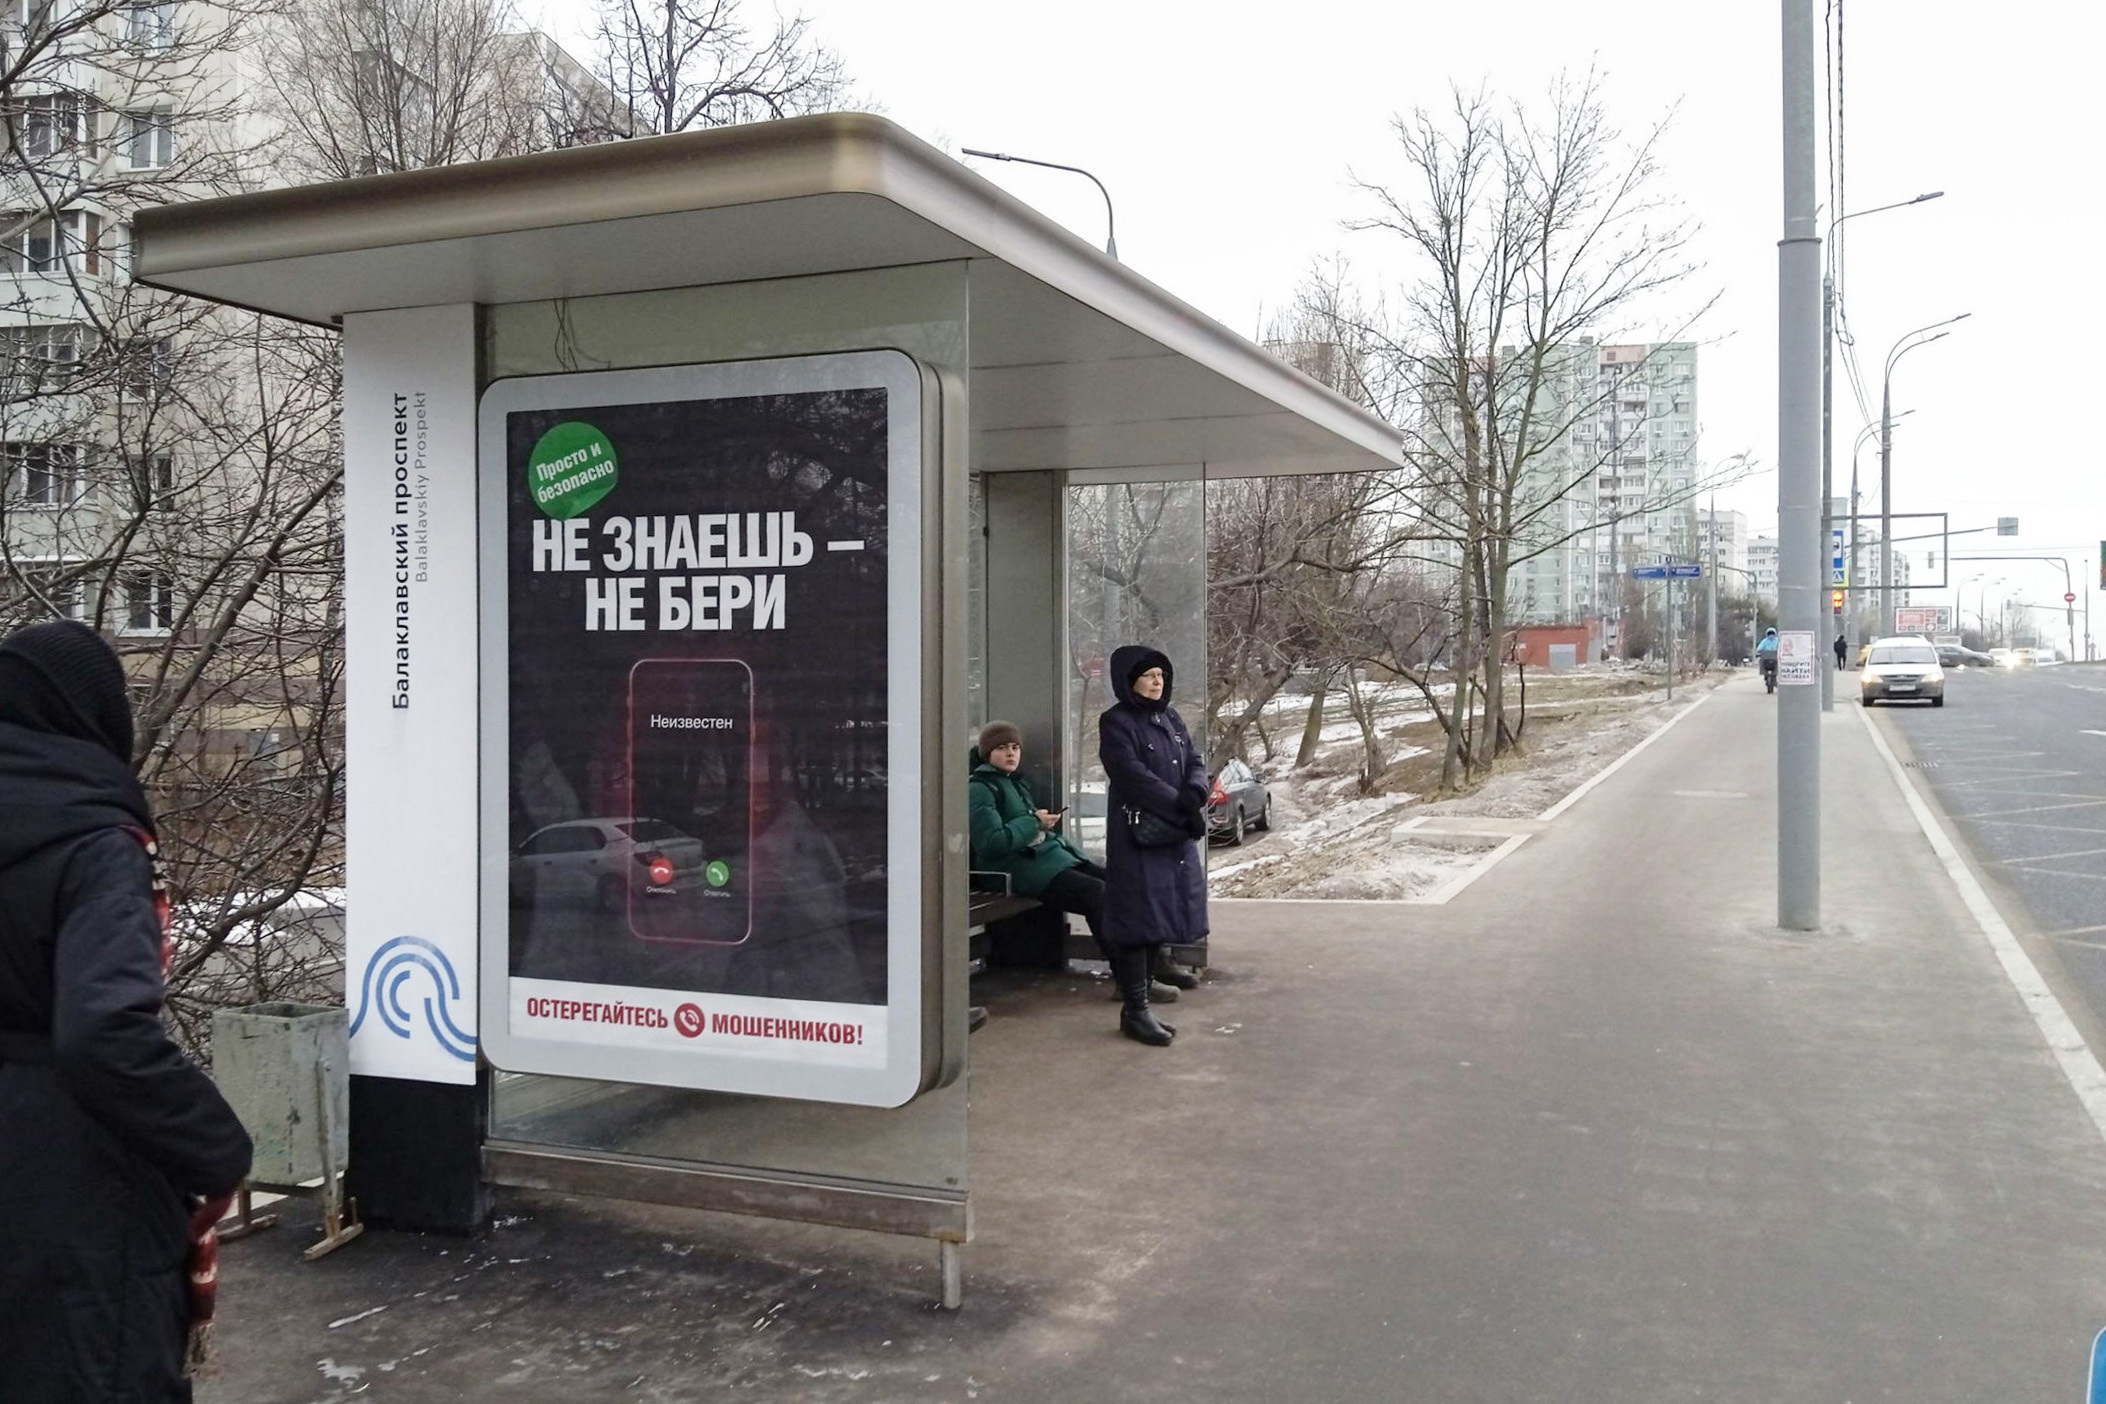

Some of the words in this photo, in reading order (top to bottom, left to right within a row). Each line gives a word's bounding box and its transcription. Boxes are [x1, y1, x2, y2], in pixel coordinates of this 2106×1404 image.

[395, 393, 412, 514] проспект
[413, 391, 429, 469] Prospekt
[536, 449, 588, 481] Просто
[590, 442, 602, 458] и
[537, 460, 614, 503] безопасно
[414, 474, 430, 582] Balaklavskiy
[533, 519, 590, 572] НЕ
[603, 511, 814, 570] ЗНАЕШЬ
[391, 525, 409, 709] Балаклавский
[586, 577, 645, 631] НЕ
[659, 574, 786, 631] БЕРИ
[651, 714, 733, 730] Неизвестен
[527, 998, 668, 1028] ОСТЕРЕГАЙТЕСЬ
[712, 1013, 863, 1045] МОШЕННИКОВ!
